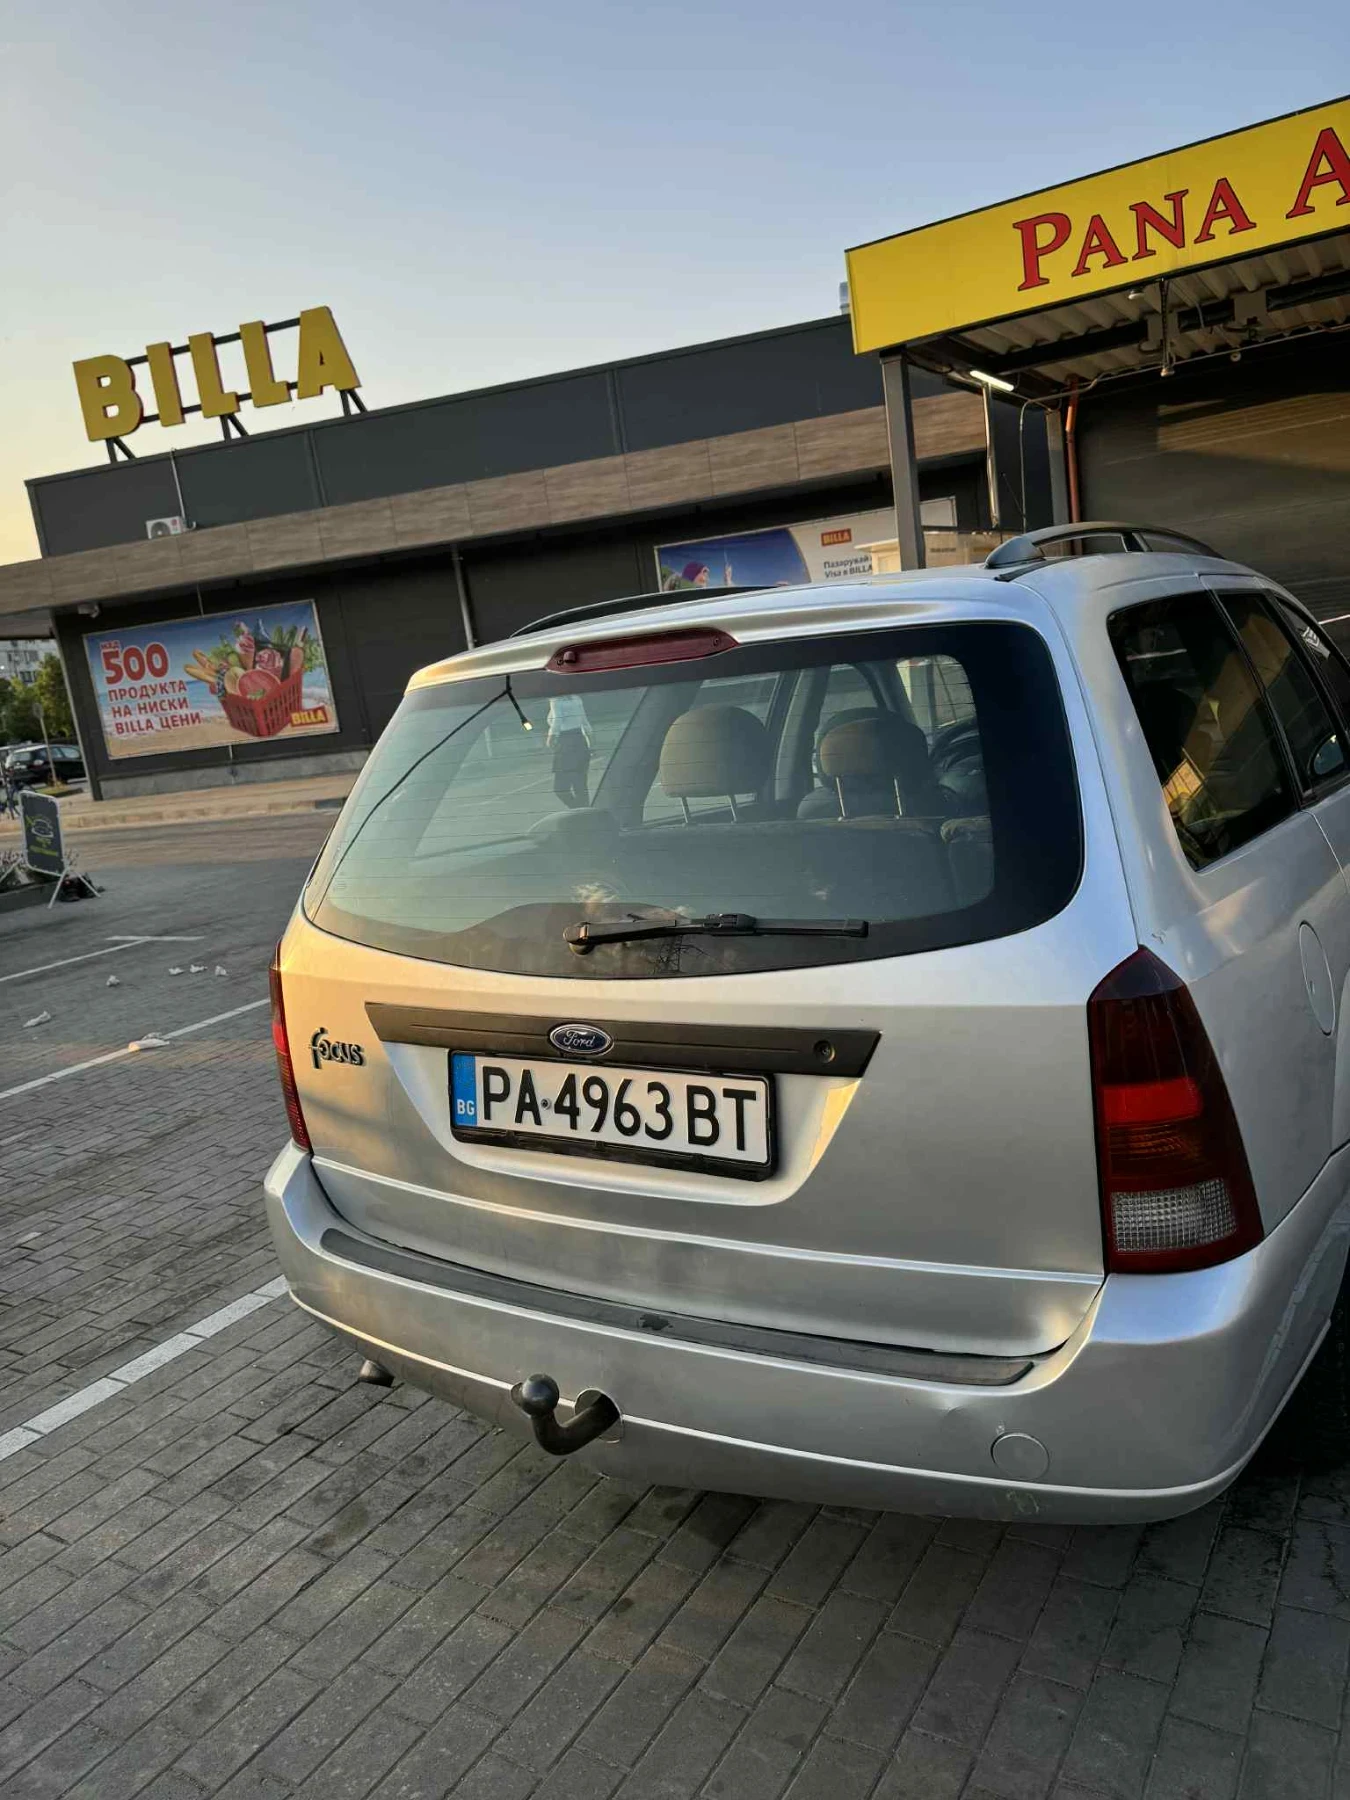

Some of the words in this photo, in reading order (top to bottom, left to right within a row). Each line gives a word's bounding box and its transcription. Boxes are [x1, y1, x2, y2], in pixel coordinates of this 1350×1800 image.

[1012, 177, 1257, 292] PANA
[72, 306, 362, 442] BILLA
[822, 531, 851, 544] BILLA
[824, 569, 842, 578] Visa
[103, 643, 169, 685] 500
[108, 680, 187, 702] ПРОДУКТА
[112, 704, 132, 718] НА
[137, 697, 189, 714] НИСКИ
[291, 709, 326, 725] BILLA
[115, 719, 154, 735] BILLA
[563, 1030, 596, 1048] Ford
[456, 1099, 475, 1115] BG
[482, 1066, 542, 1126] PA
[554, 1073, 673, 1140] 4963
[686, 1084, 757, 1151] BT
